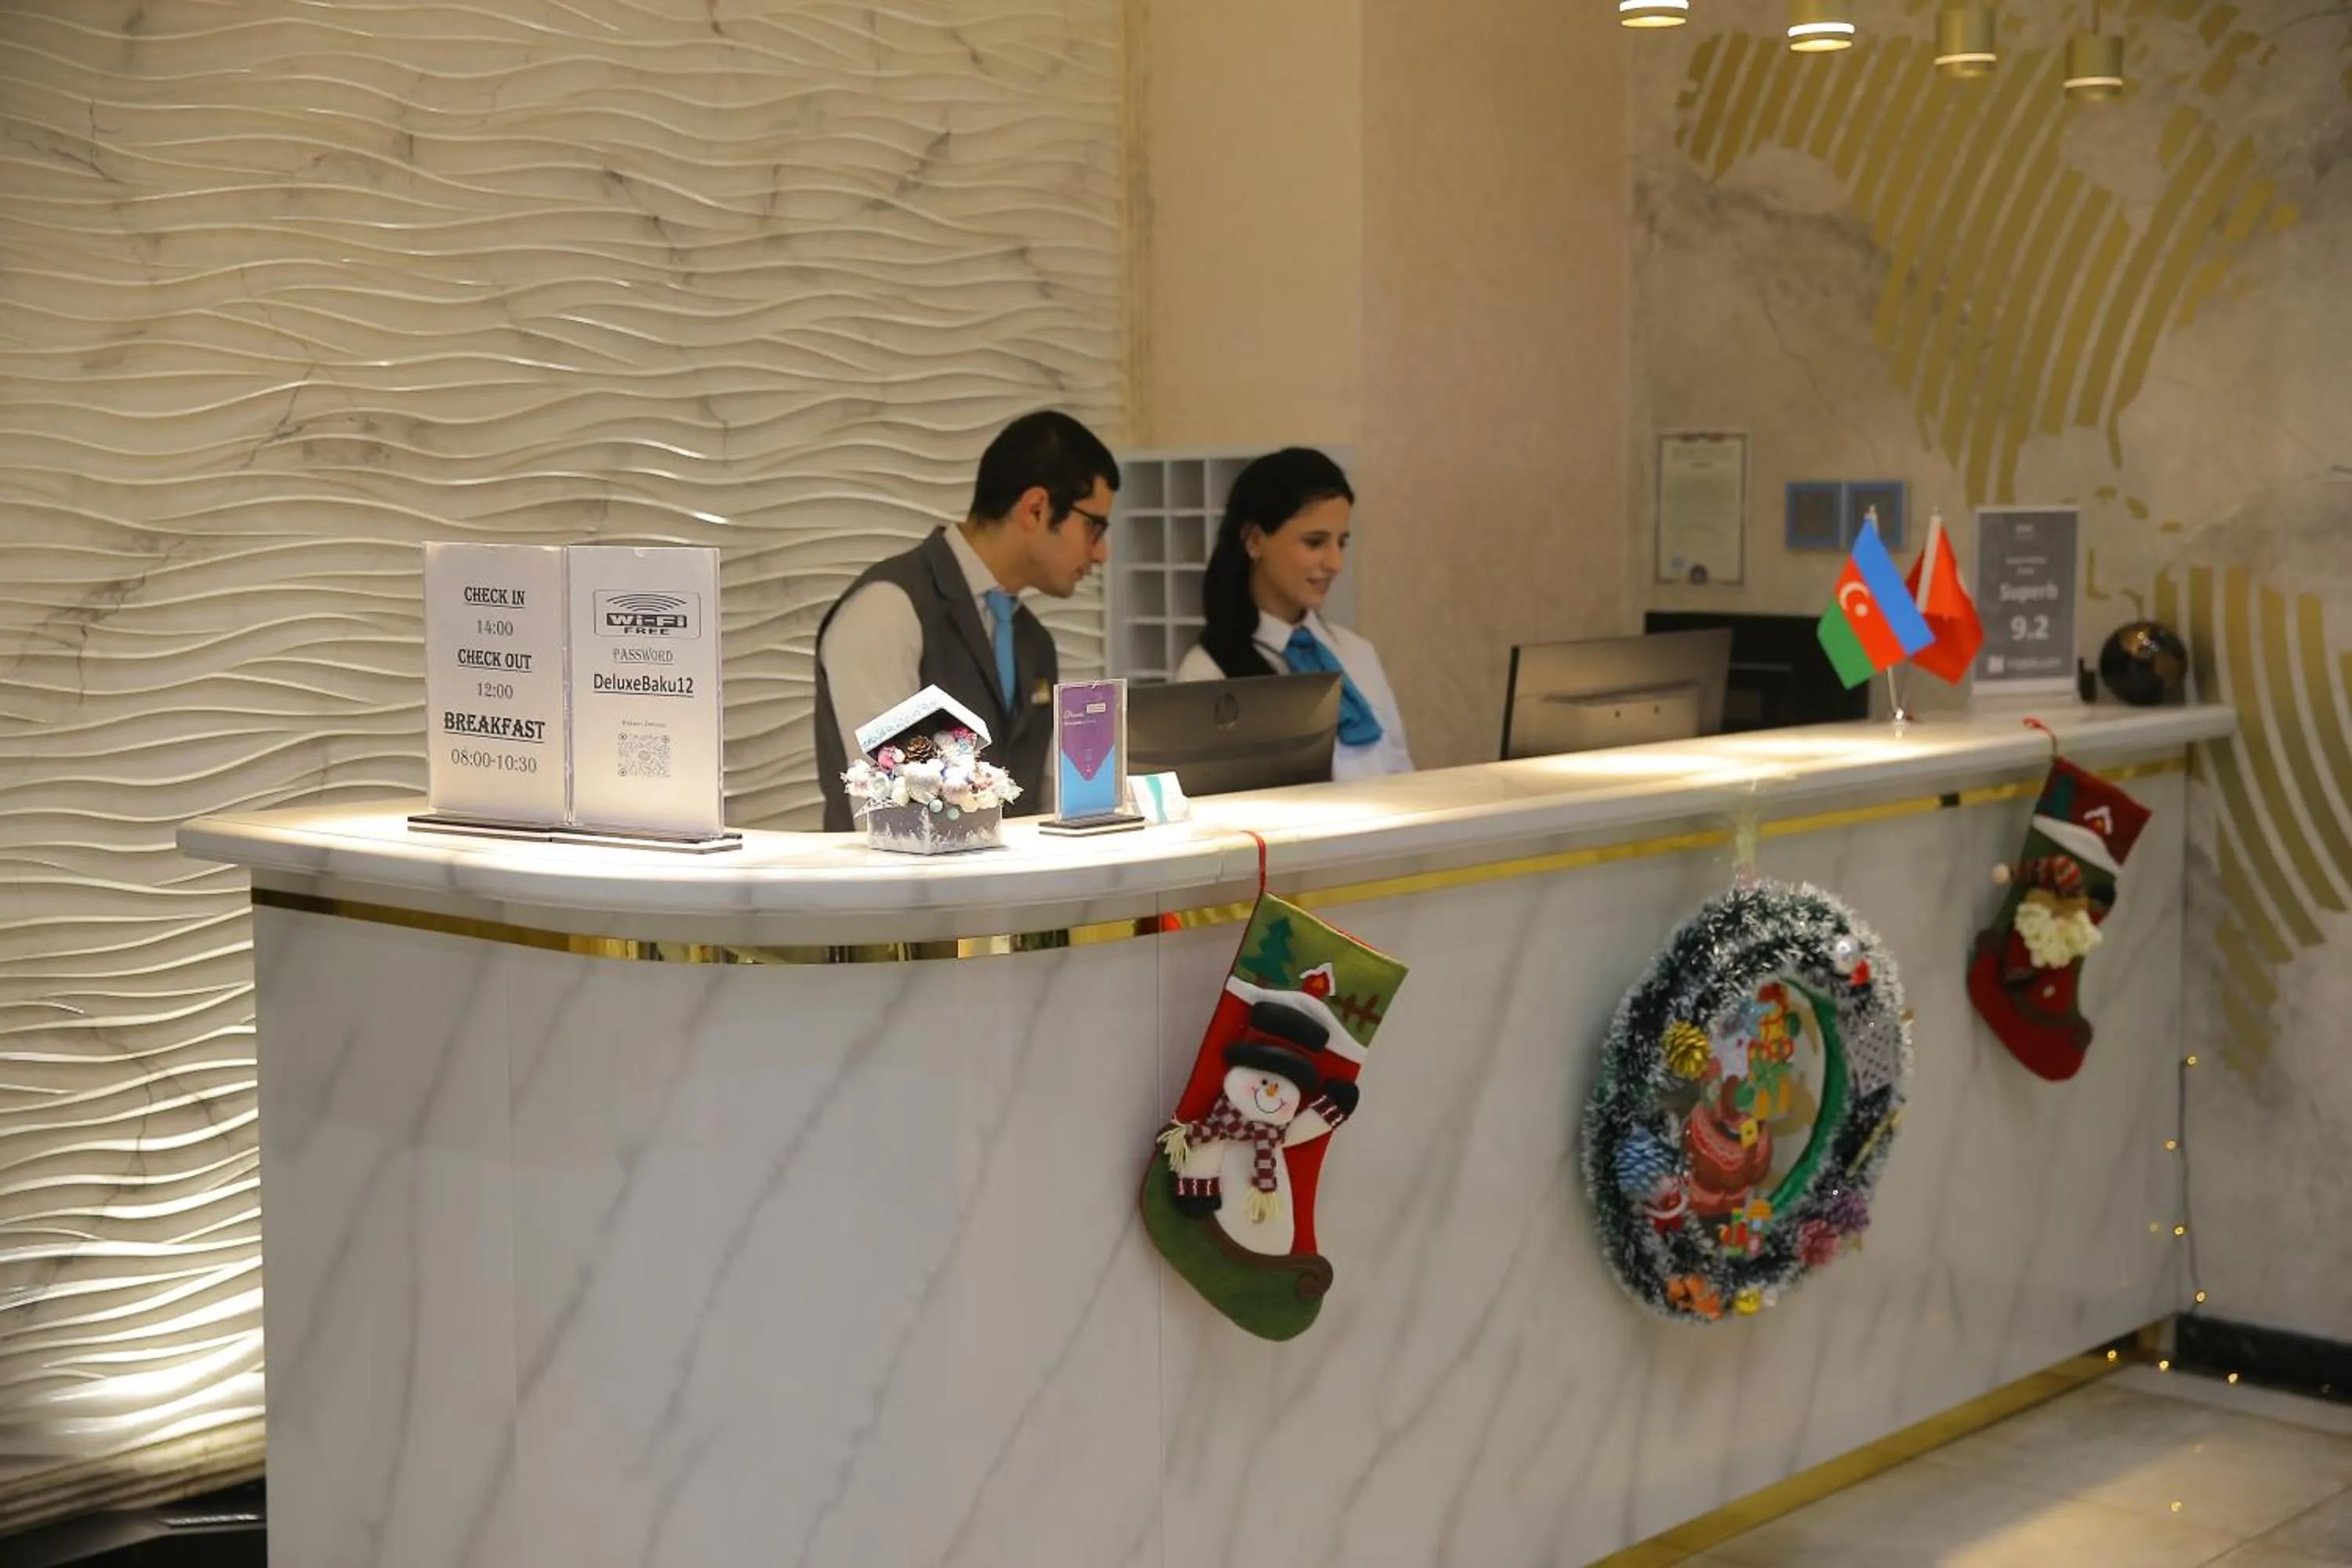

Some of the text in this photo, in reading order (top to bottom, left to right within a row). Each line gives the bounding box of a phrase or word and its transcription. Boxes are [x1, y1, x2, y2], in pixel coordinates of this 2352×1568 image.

[464, 586, 525, 606] CHECK IN
[476, 619, 514, 637] 14:00
[624, 626, 670, 635] FREE
[2010, 615, 2049, 641] 9.2
[458, 648, 532, 670] CHECK OUT
[612, 648, 673, 662] PASSWORD
[477, 682, 514, 699] 12:00
[593, 673, 694, 695] DeluxeBaku12
[444, 711, 546, 739] BREAKFAST
[451, 748, 537, 773] 08:00-10:30
